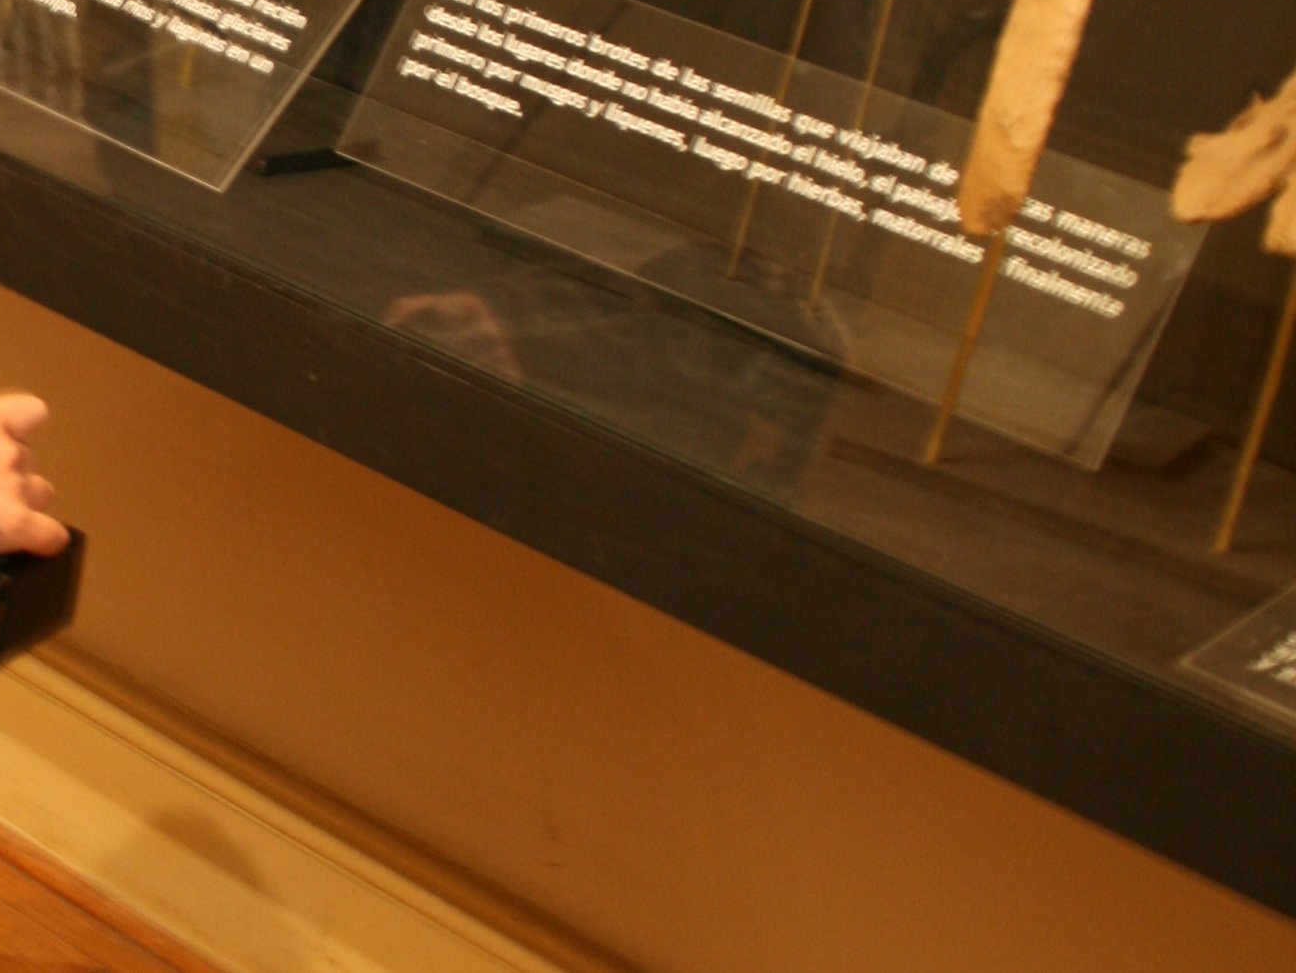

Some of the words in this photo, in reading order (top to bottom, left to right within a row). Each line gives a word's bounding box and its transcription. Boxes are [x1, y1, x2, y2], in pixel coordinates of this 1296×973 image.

[399, 57, 437, 80] por
[432, 68, 459, 90] el
[453, 75, 523, 117] bosque.
[411, 32, 486, 70] primero
[482, 59, 521, 82] por
[518, 73, 589, 109] musgos
[584, 99, 606, 118] y
[692, 136, 749, 170] luego
[745, 160, 789, 184] por
[786, 172, 867, 221] hierbas,
[871, 208, 985, 263] matorrales
[1004, 255, 1124, 316] finalmente
[424, 6, 478, 37] desde
[474, 23, 505, 47] los
[500, 33, 567, 70] lugares
[563, 58, 623, 91] donde
[620, 80, 649, 101] no
[696, 109, 793, 155] alcanzado
[788, 144, 817, 164] el
[812, 149, 868, 188] hielo,
[868, 175, 897, 196] el
[1005, 225, 1137, 287] recolonizado
[501, 6, 588, 47] primeros
[585, 33, 650, 70] brotes
[649, 59, 680, 81] de
[679, 67, 711, 93] las
[709, 82, 792, 123] semillas
[791, 113, 836, 139] que
[836, 128, 926, 173] viajaban
[926, 162, 959, 185] de
[1055, 210, 1150, 258] maneras
